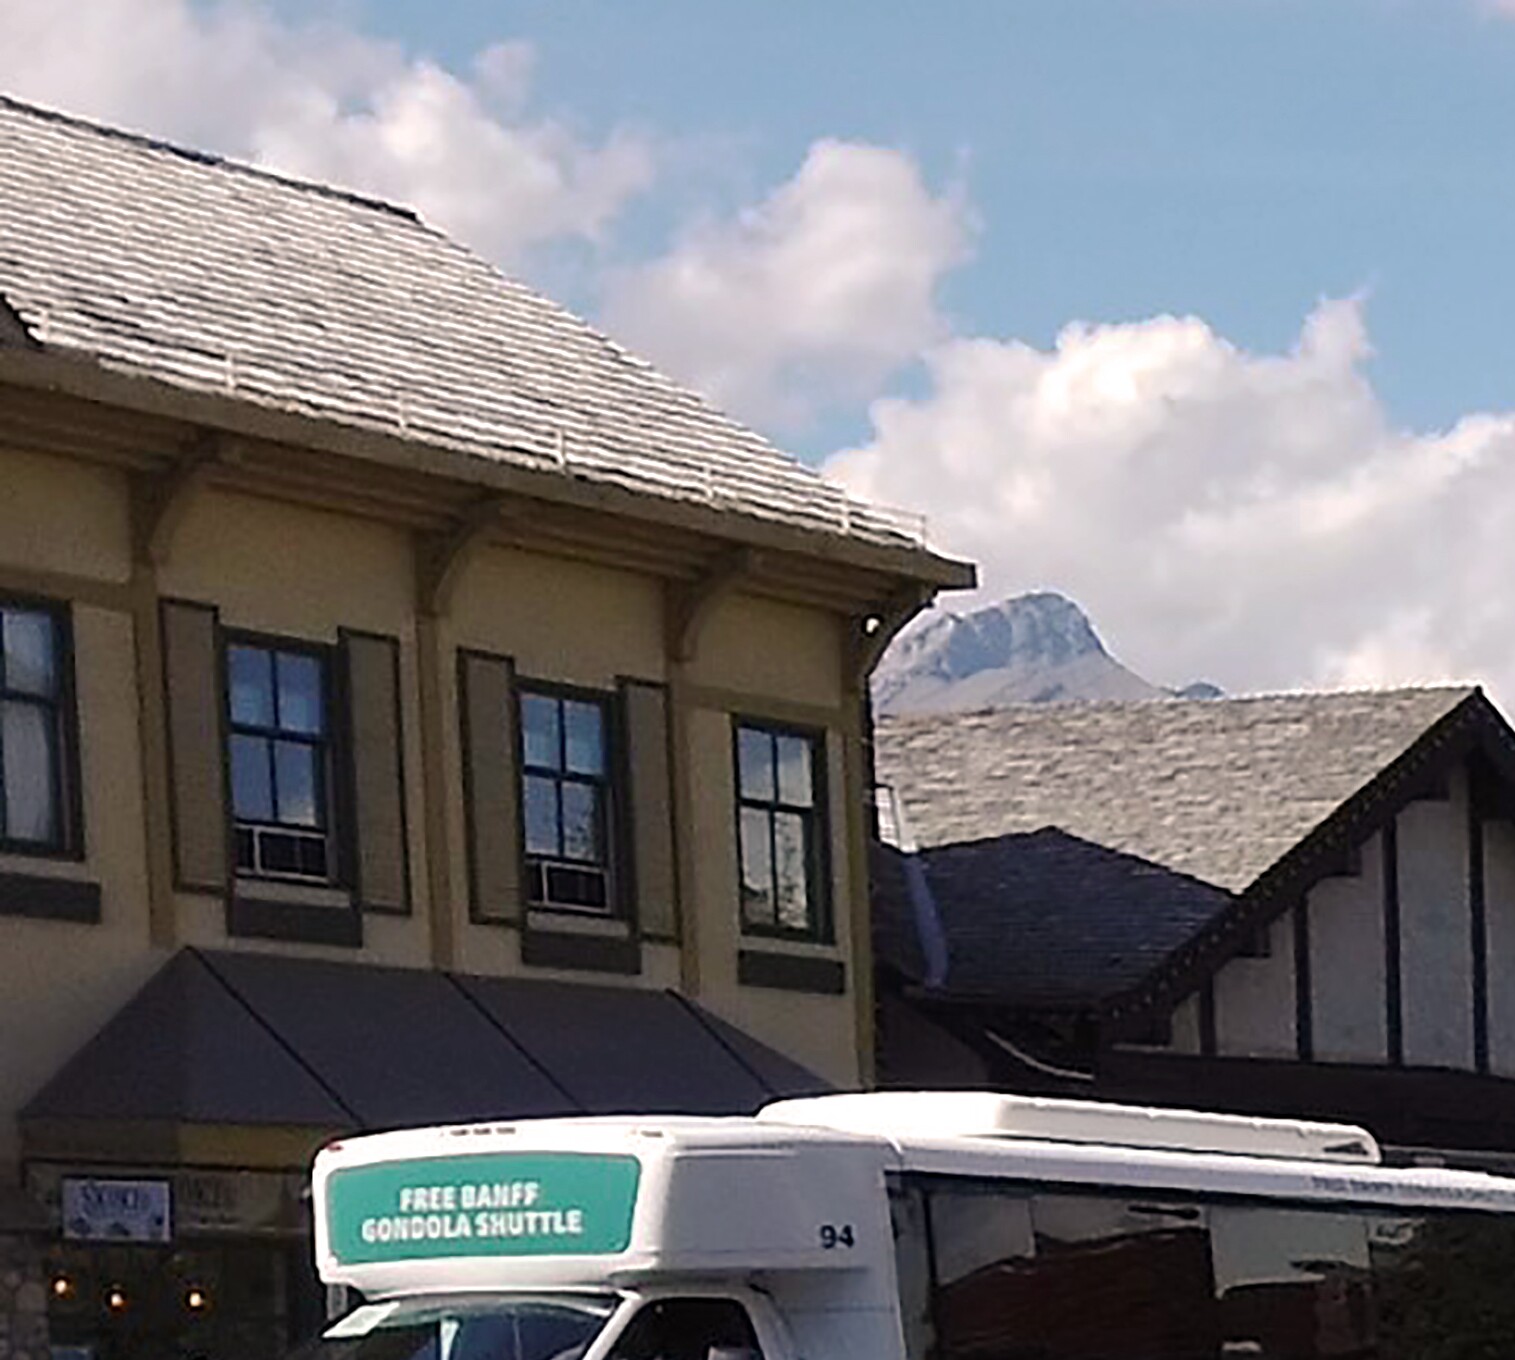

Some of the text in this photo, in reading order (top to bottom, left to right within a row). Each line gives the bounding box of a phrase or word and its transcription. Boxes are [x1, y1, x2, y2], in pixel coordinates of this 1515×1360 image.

[400, 1181, 540, 1213] FREE BANFF
[361, 1209, 583, 1243] GONDOLA SHUTTLE
[820, 1224, 855, 1250] 94
